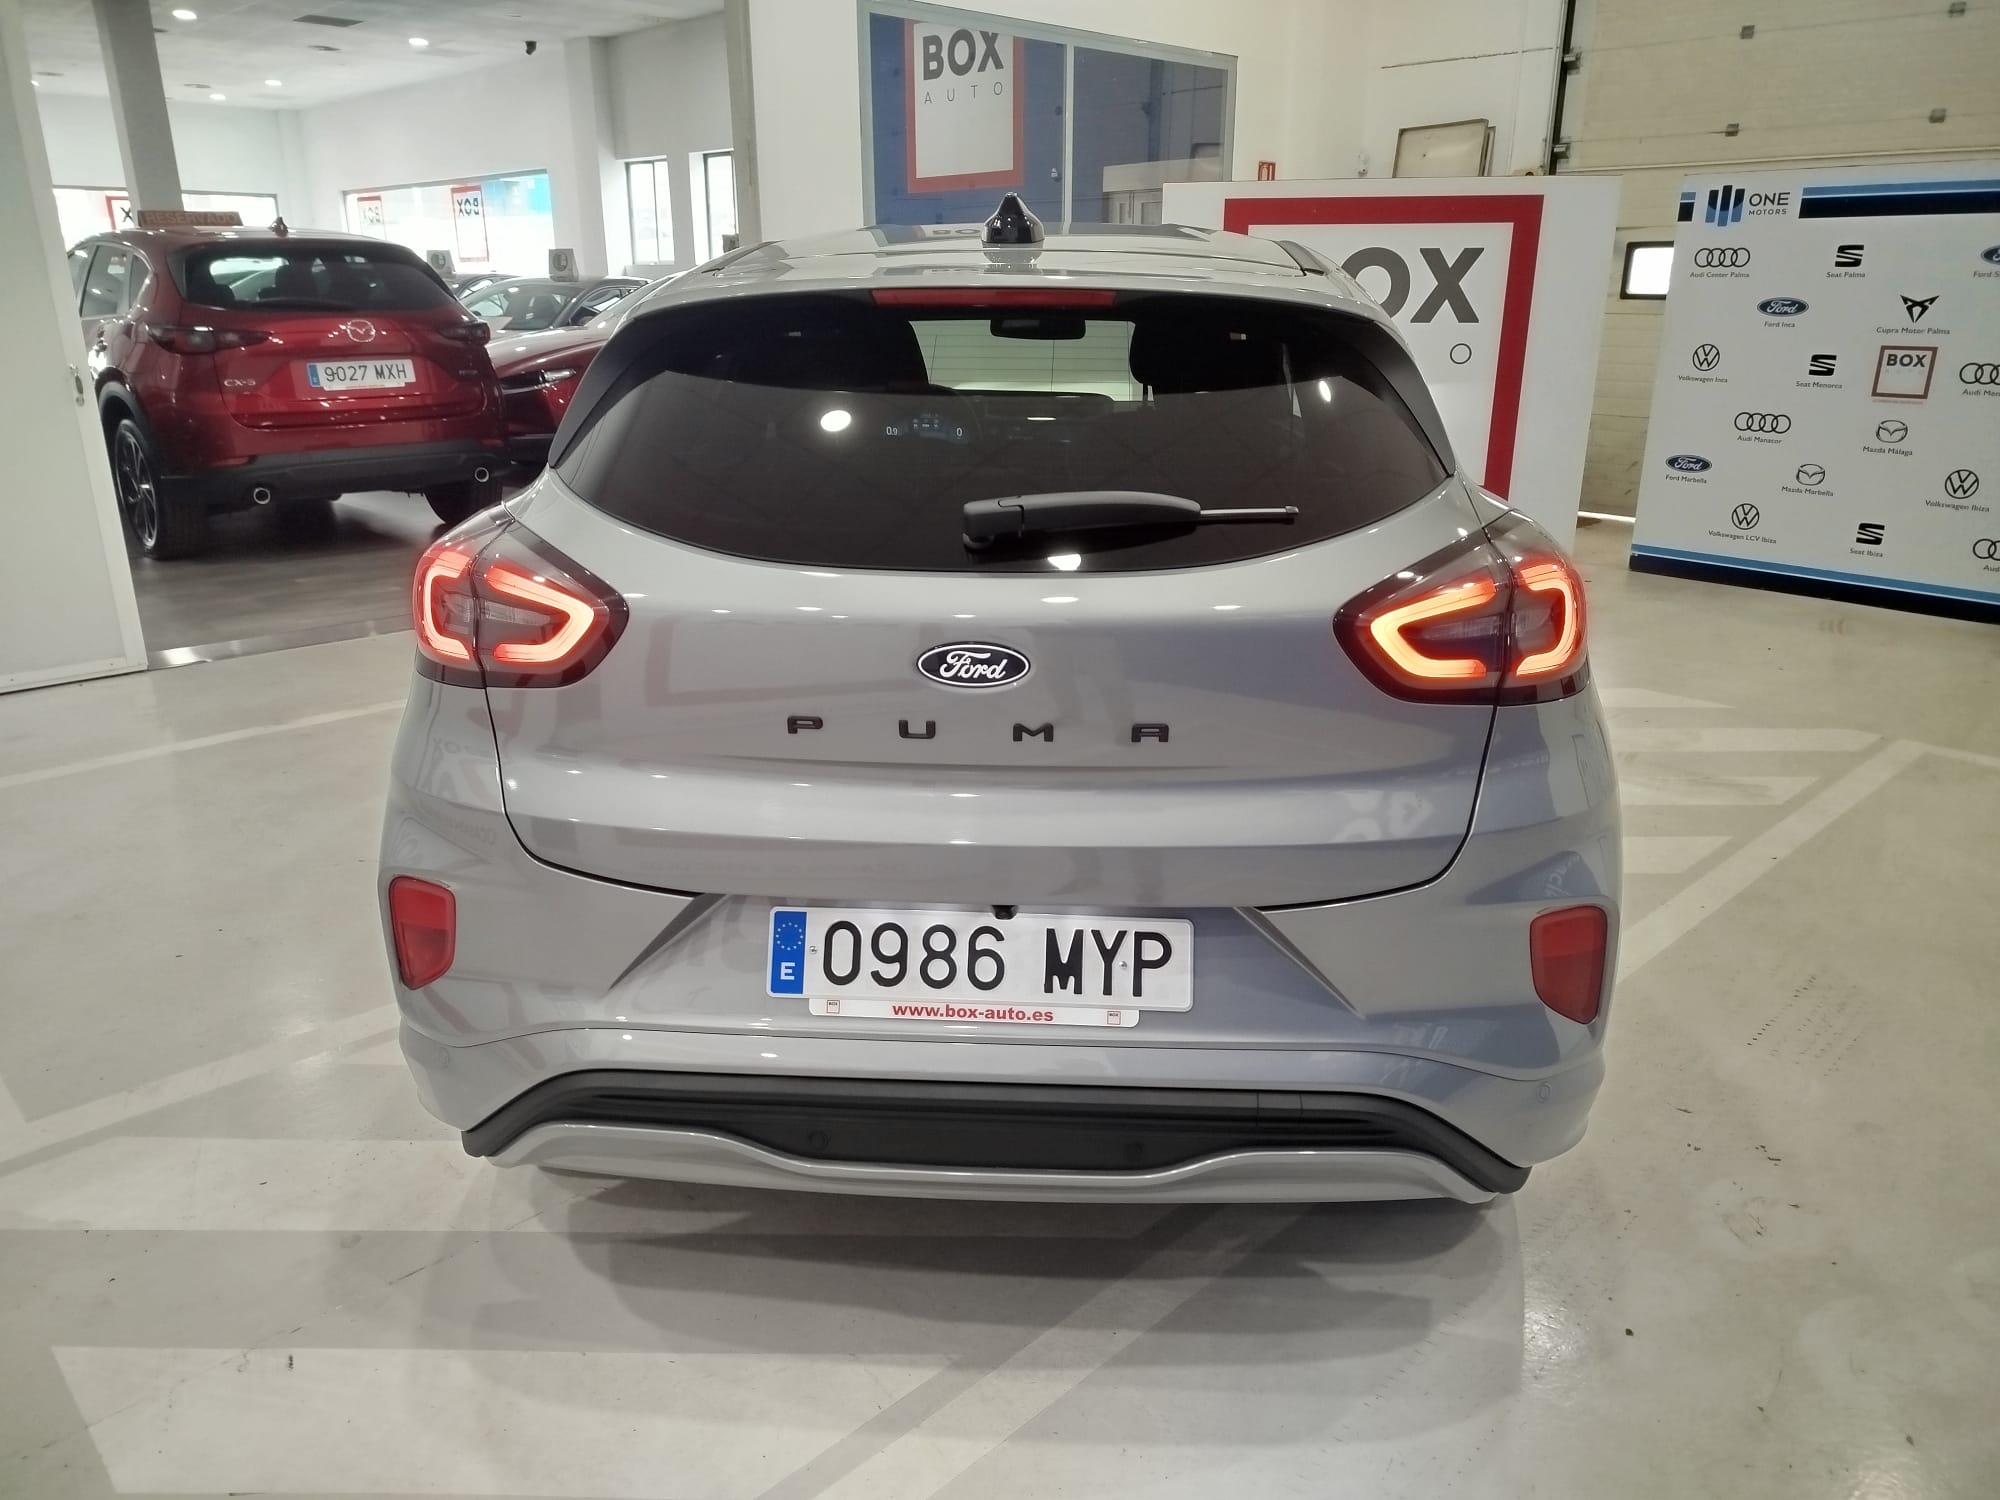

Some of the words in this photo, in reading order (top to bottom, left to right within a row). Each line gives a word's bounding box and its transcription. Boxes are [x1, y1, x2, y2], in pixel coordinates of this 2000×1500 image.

[922, 29, 1004, 80] BOX
[924, 81, 1003, 104] AUTO
[1749, 192, 1790, 207] ONE
[1749, 208, 1787, 216] MOTORS
[1689, 271, 1705, 279] Audi
[1706, 271, 1728, 279] Center
[1730, 271, 1750, 279] Palma
[1826, 271, 1842, 279] Seat
[1844, 271, 1866, 279] Palma
[1767, 300, 1798, 314] Ford
[1764, 320, 1780, 328] Ford
[1876, 326, 1899, 335] Cupra
[1901, 326, 1925, 334] Motor
[1927, 327, 1950, 335] Palma
[1886, 353, 1928, 367] BOX
[324, 365, 368, 382] 9027
[374, 363, 408, 380] MXH
[1678, 375, 1714, 383] Volkswagen
[1737, 434, 1752, 442] Audi
[1753, 435, 1783, 444] Manacor
[1862, 445, 1886, 454] Mazda
[1674, 456, 1703, 470] Ford
[1665, 474, 1680, 482] Ford
[1681, 475, 1708, 484] Marbella
[1781, 485, 1803, 494] Mazda
[1804, 488, 1834, 497] Marbella
[1925, 500, 1969, 511] Volkswagen
[1971, 504, 1990, 512] Ibiza
[1708, 530, 1745, 540] Volkswagen
[1761, 536, 1777, 544] Ibiza
[1850, 547, 1865, 555] Seat
[939, 650, 1007, 680] Ford
[823, 920, 1005, 991] 0986
[1043, 927, 1173, 997] MYP
[779, 961, 796, 980] E
[892, 1004, 1054, 1022] www.box-auto.es
